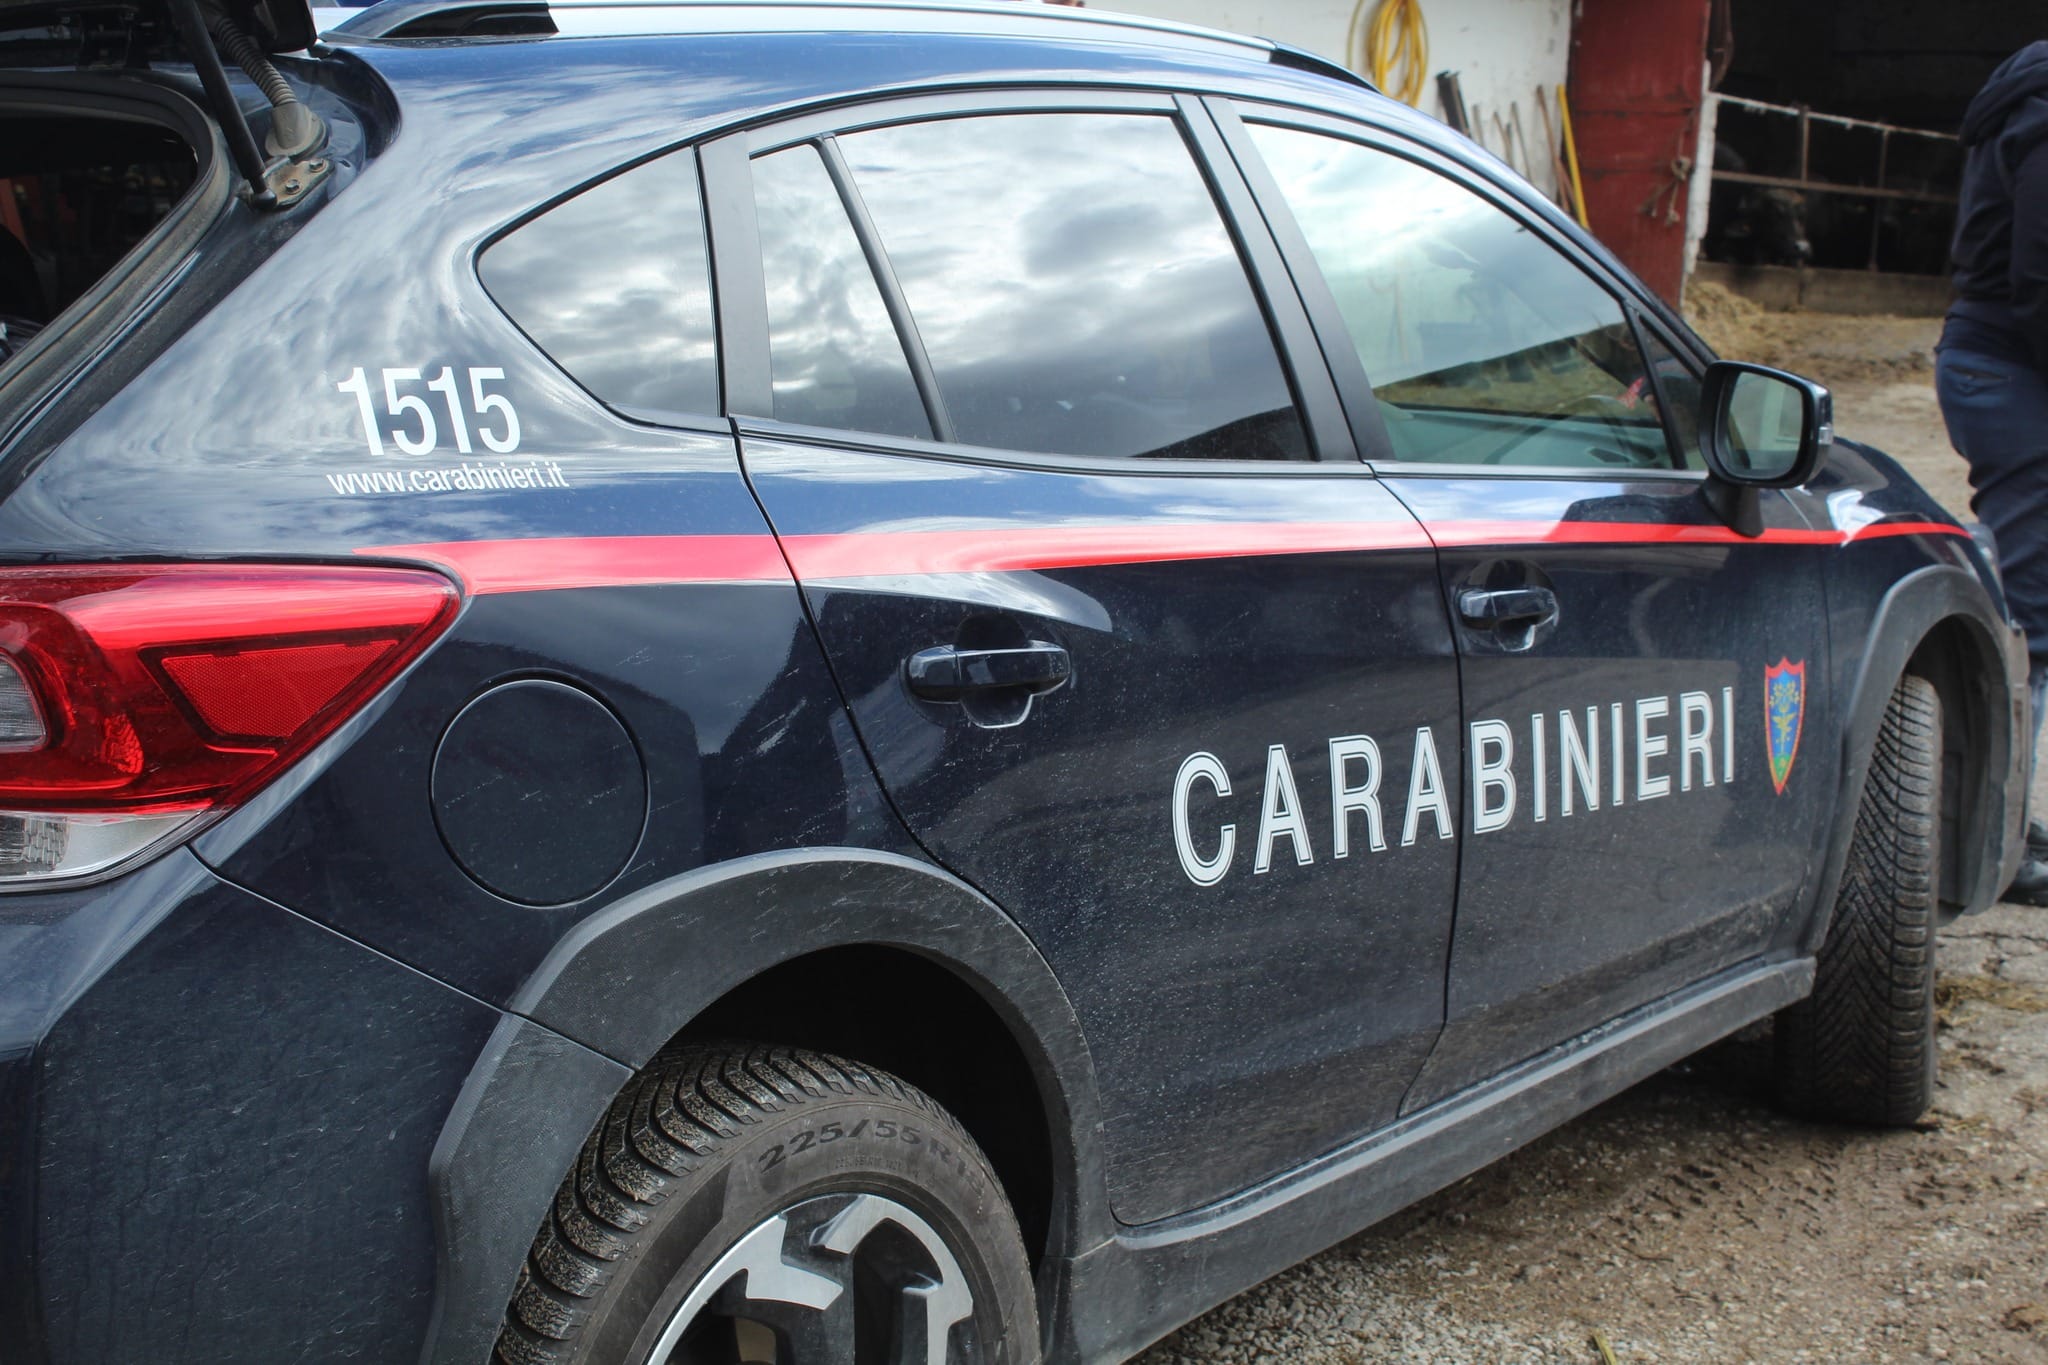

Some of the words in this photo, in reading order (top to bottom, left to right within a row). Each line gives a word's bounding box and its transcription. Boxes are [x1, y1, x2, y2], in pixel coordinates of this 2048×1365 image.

[338, 366, 521, 456] 1515
[326, 461, 569, 495] www.carabinieri.it
[1172, 686, 1735, 887] CARABINIERI
[758, 1118, 921, 1174] 225/55
